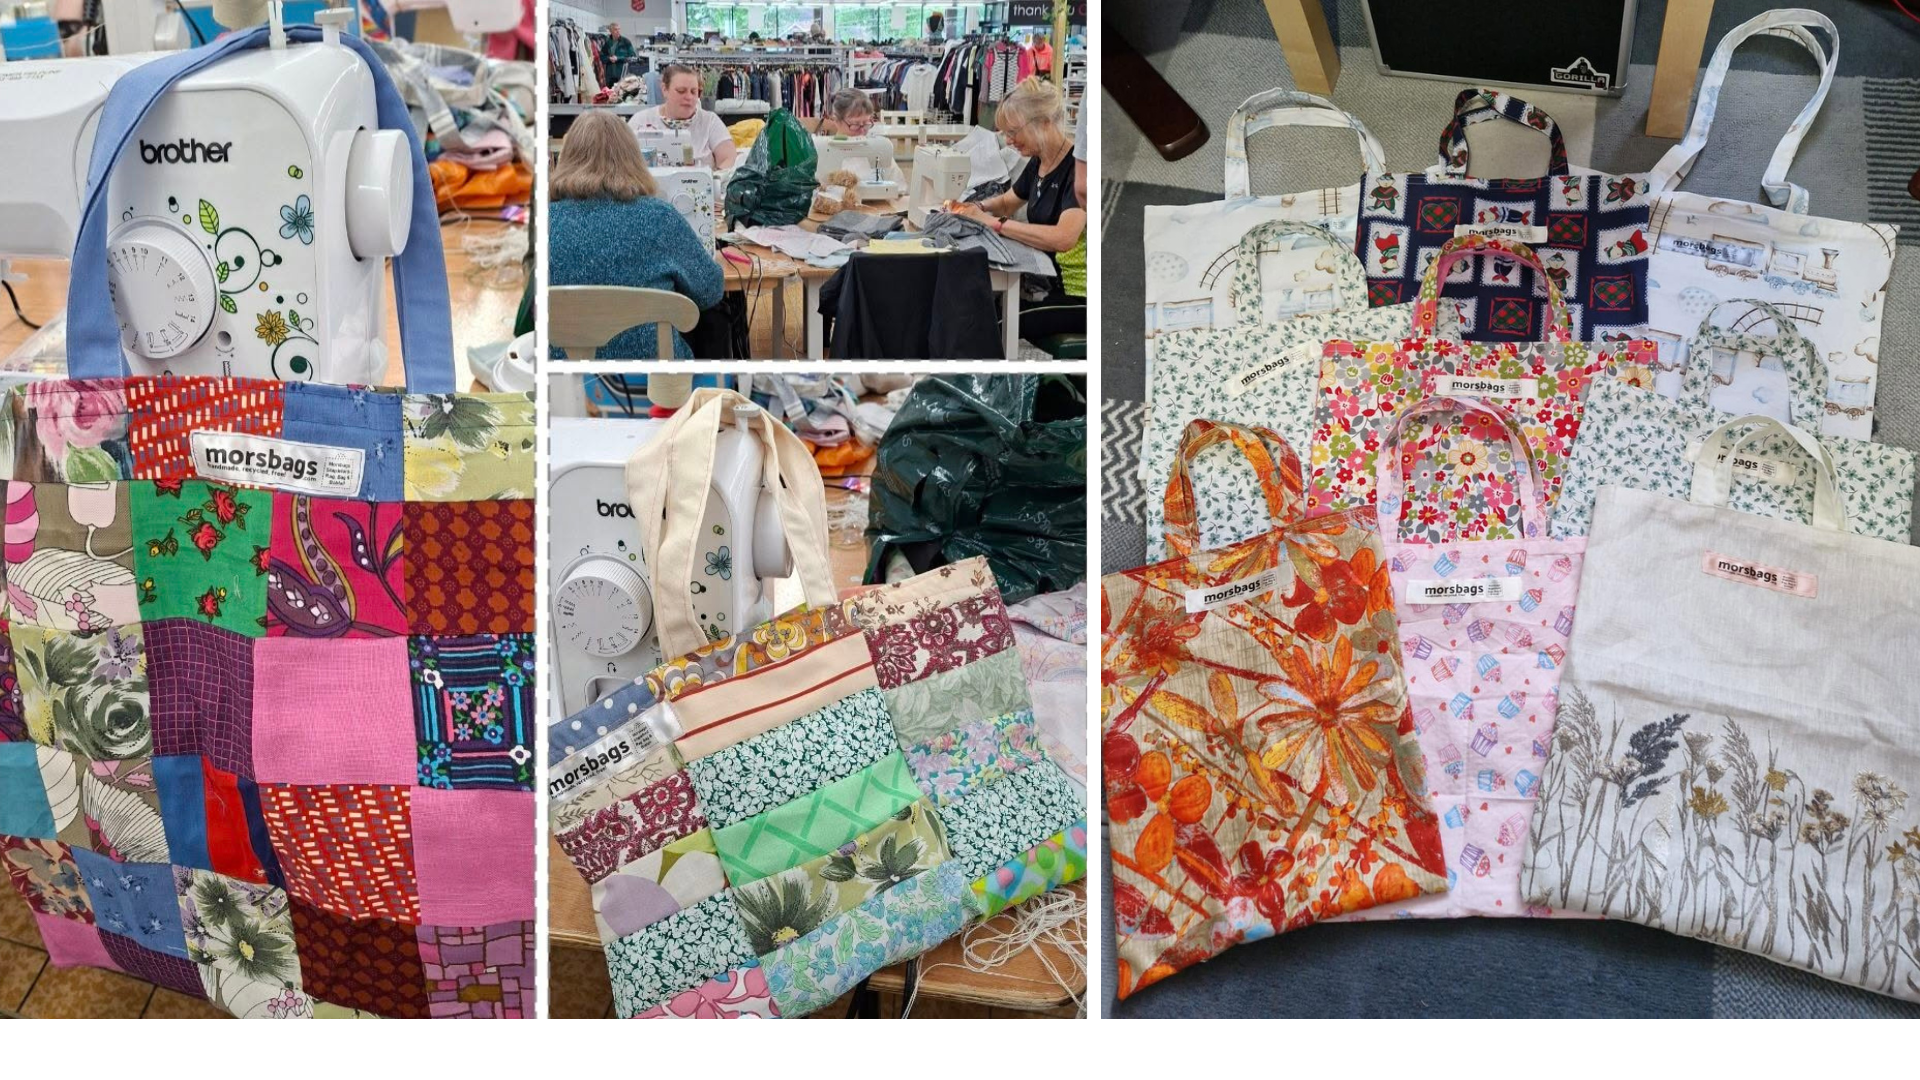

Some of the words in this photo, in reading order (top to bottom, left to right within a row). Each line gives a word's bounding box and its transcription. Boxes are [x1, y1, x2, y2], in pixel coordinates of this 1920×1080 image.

[1013, 4, 1048, 16] thank
[1555, 72, 1605, 83] GORILLA
[139, 138, 232, 164] brother
[1673, 239, 1722, 255] morsbags
[1240, 355, 1290, 385] morsbags
[1452, 381, 1505, 393] morsbags
[206, 448, 318, 479] morsbags
[1718, 560, 1778, 583] morsbags
[1204, 580, 1261, 603] morsbags
[1425, 584, 1484, 596] morsbags
[550, 741, 630, 795] morsbags
